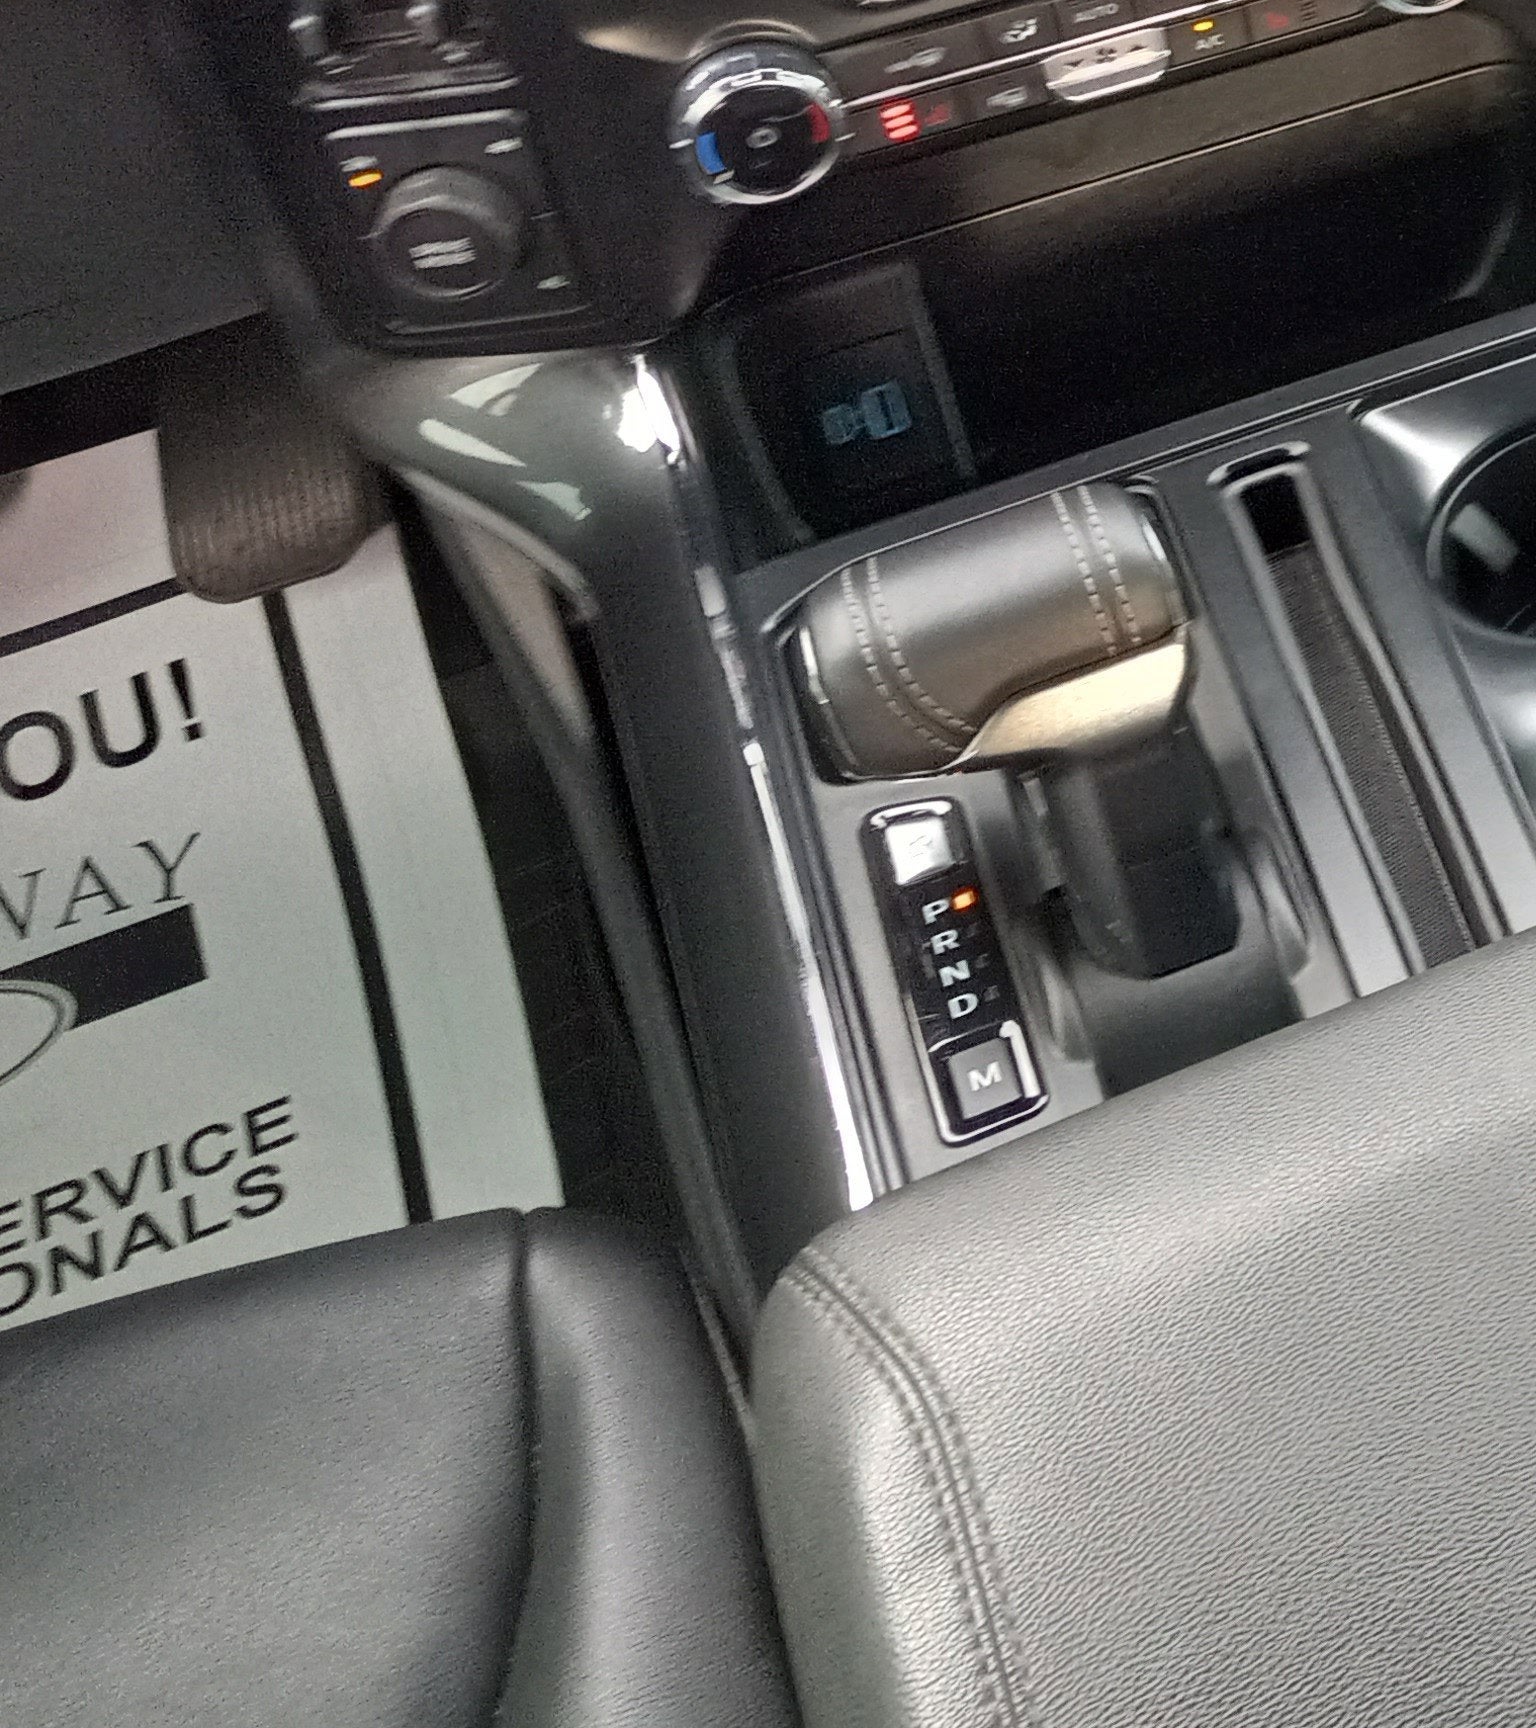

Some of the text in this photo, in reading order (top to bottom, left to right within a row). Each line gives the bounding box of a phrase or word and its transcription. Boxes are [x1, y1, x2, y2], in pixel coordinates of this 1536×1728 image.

[1195, 33, 1226, 51] A/C
[922, 899, 949, 925] P
[930, 928, 960, 956] R
[938, 959, 971, 987] N
[947, 992, 979, 1020] D
[967, 1060, 1003, 1093] M
